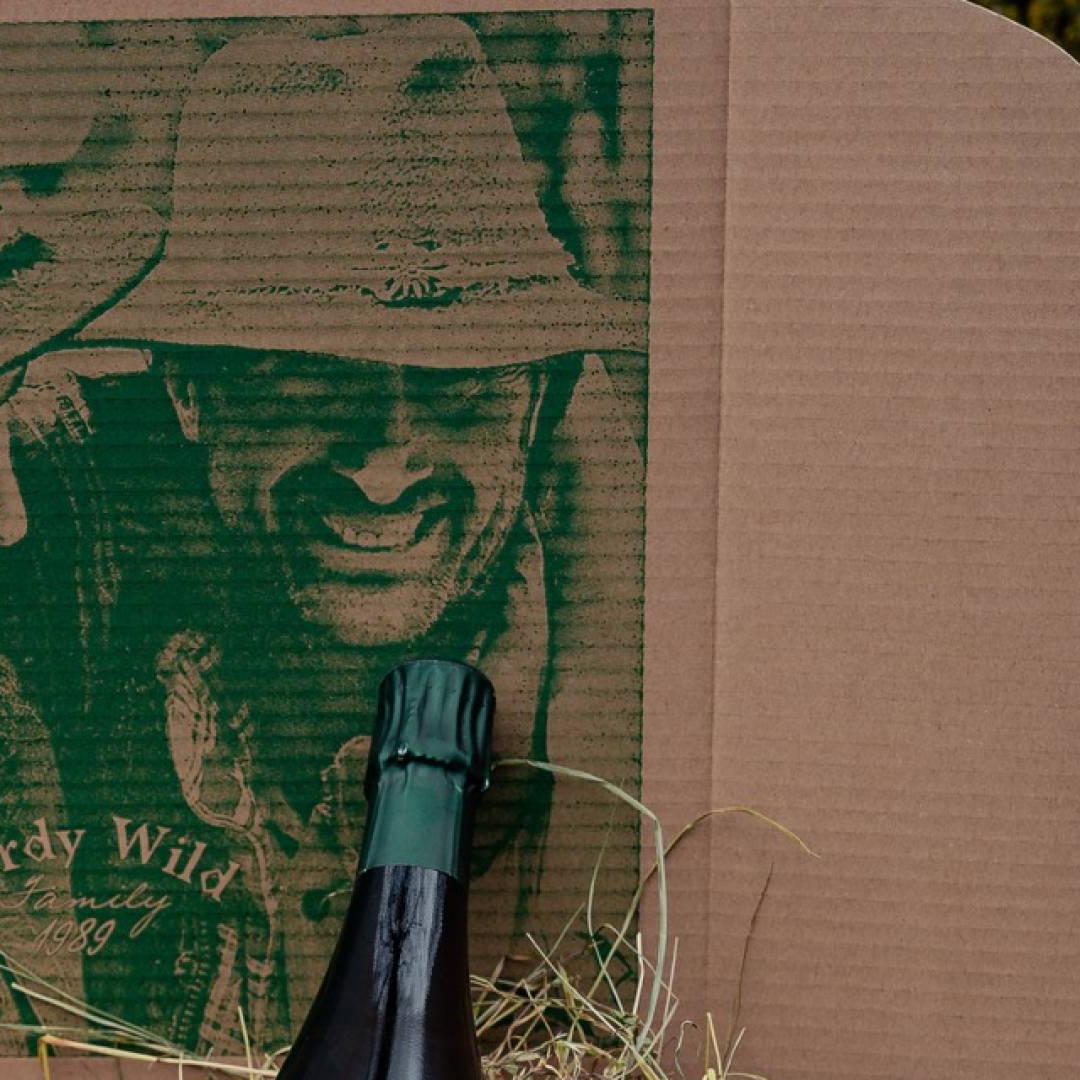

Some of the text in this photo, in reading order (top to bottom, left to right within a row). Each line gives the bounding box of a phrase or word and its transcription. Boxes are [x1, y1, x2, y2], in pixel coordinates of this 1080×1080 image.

[112, 815, 241, 902] Wild
[2, 873, 171, 939] Family
[33, 916, 117, 956] 1989
